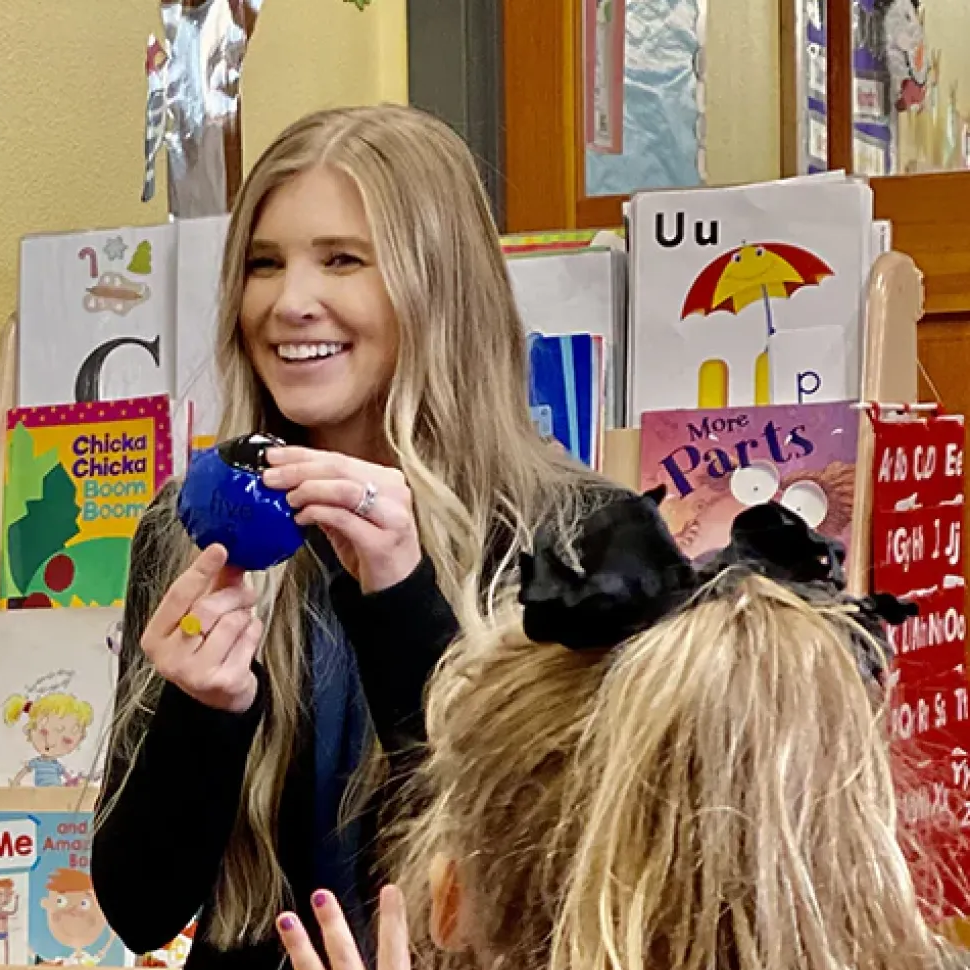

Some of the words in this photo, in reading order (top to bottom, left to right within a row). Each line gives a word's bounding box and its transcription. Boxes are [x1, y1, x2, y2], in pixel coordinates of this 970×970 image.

[686, 414, 750, 442] More
[72, 432, 148, 457] Chicka
[71, 455, 148, 478] Chicka
[659, 420, 814, 498] Parts
[83, 478, 147, 498] Boom
[81, 501, 145, 521] Boom
[57, 821, 87, 834] and
[69, 854, 91, 867] Bo
